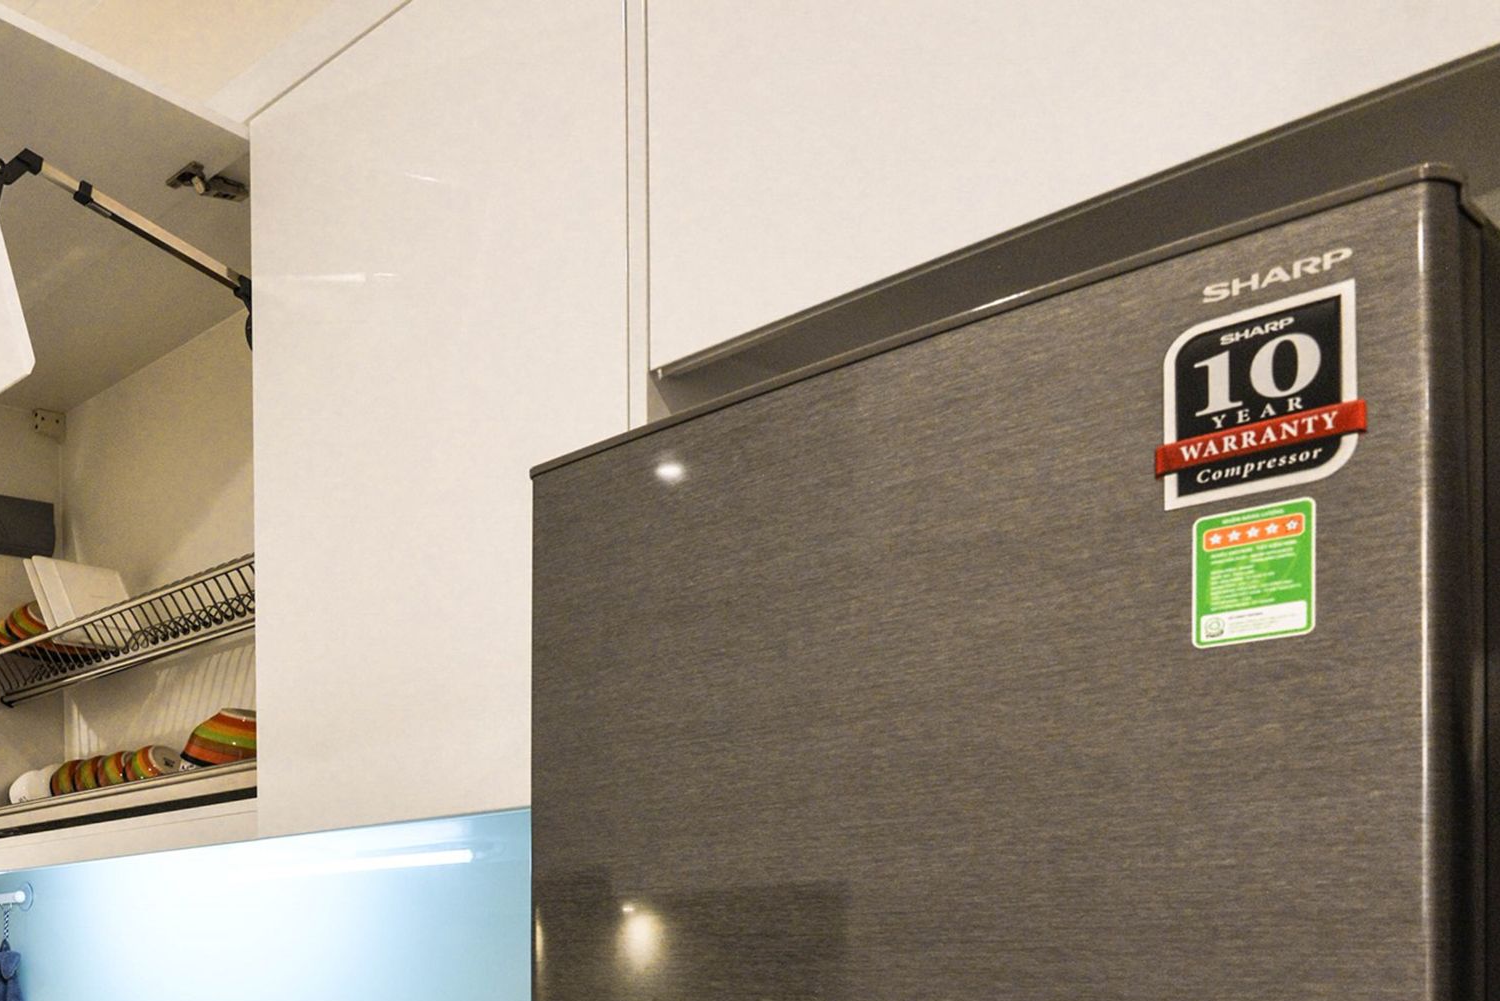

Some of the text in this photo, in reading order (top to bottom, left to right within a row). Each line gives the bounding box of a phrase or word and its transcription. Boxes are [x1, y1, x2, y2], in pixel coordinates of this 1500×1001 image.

[1202, 247, 1353, 303] SHARP
[1220, 316, 1294, 346] SHARP
[1194, 332, 1322, 417] 10
[1212, 397, 1304, 429] YEAR
[1180, 411, 1339, 463] WARRANTY
[1196, 446, 1323, 484] Compressor
